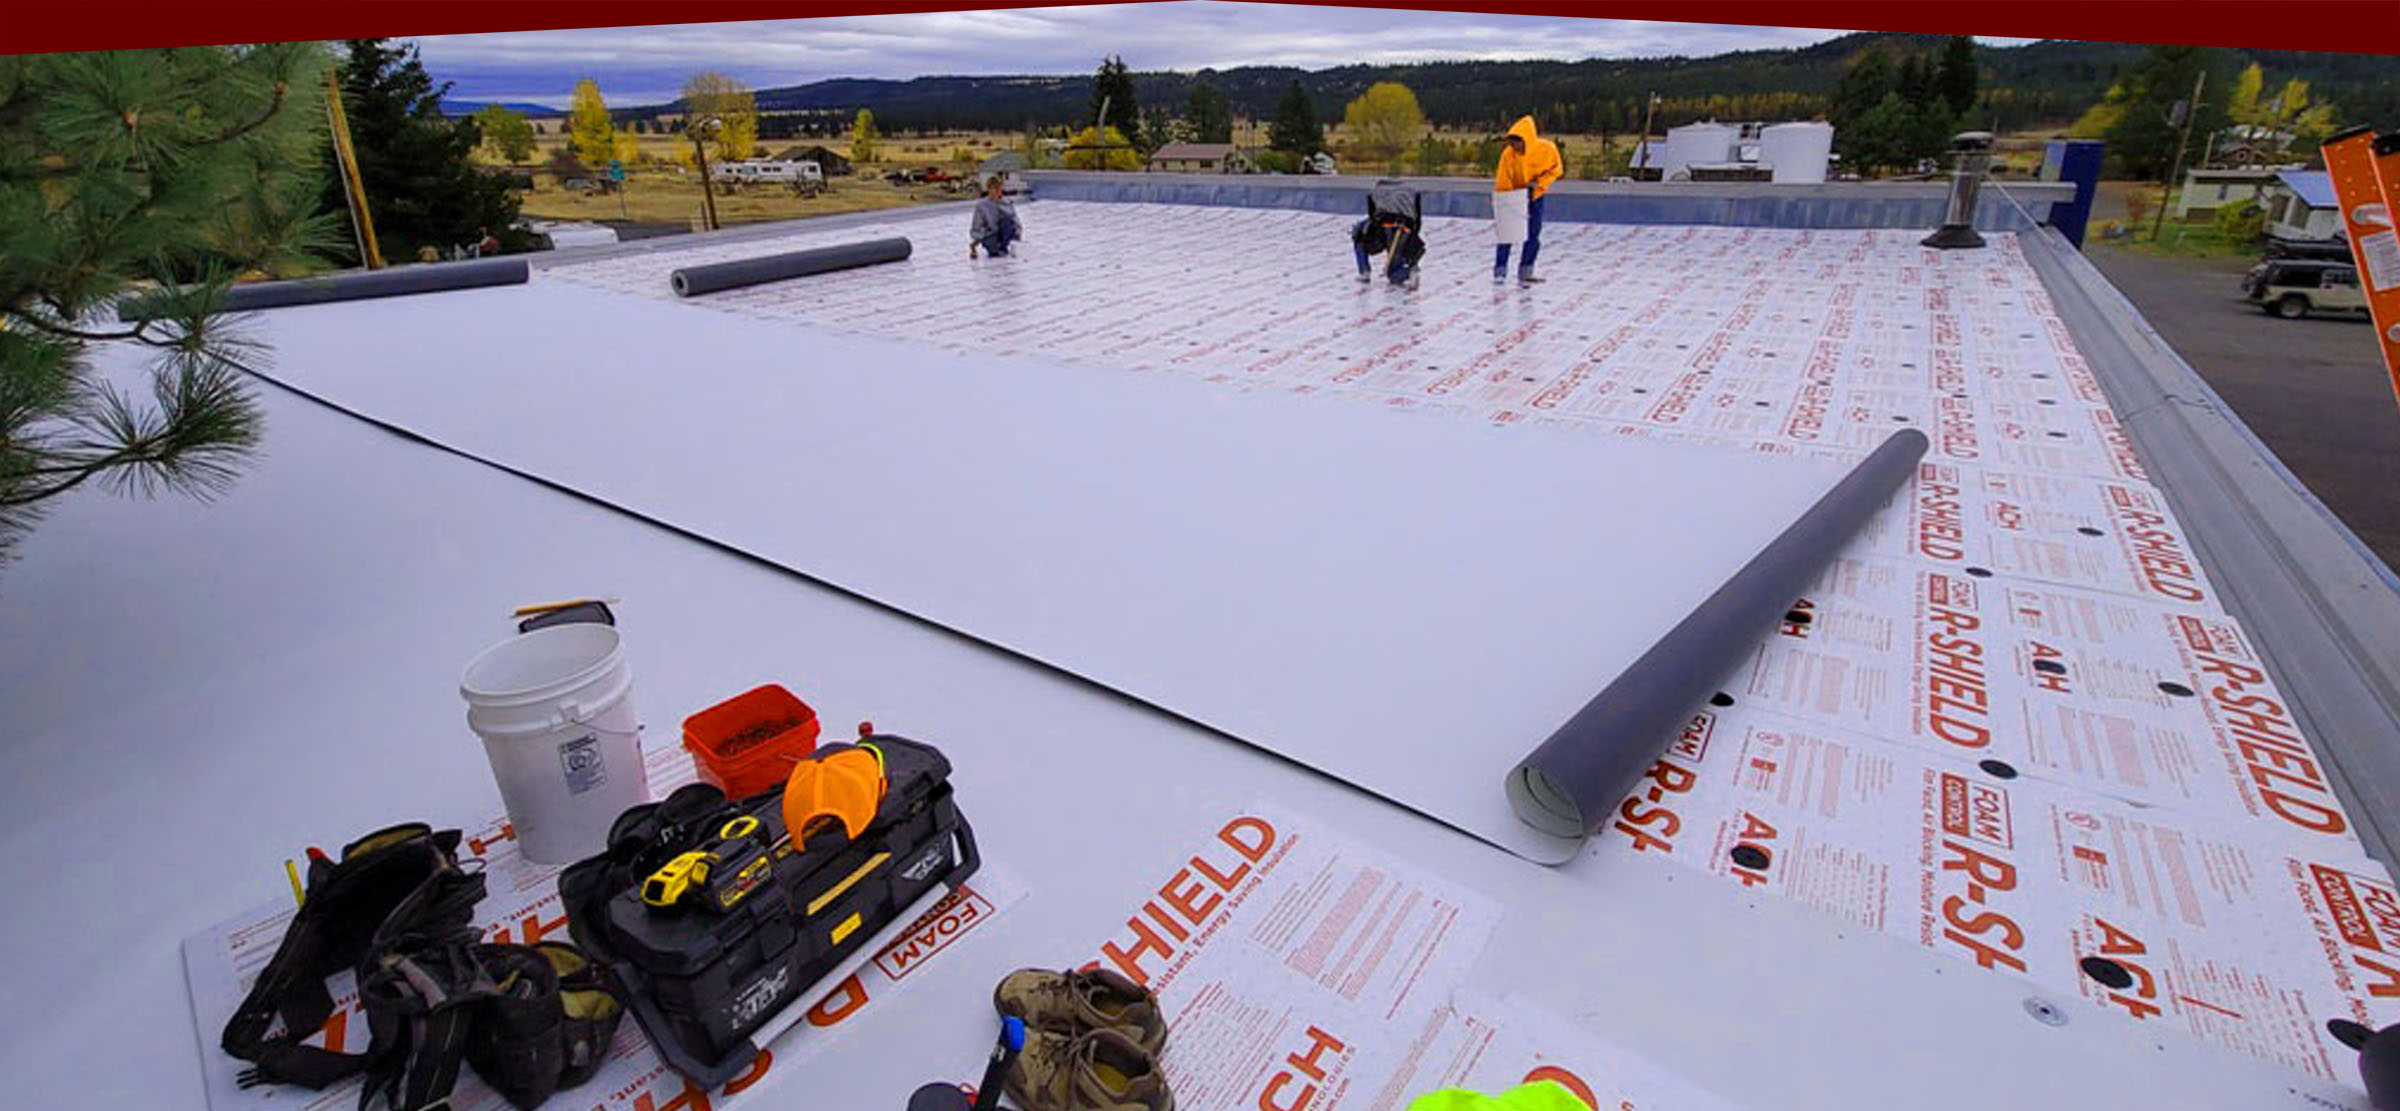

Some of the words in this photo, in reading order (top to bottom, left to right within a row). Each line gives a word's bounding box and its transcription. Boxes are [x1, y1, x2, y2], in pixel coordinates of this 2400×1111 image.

[1929, 607, 1990, 749] R-SHIELD
[2201, 657, 2346, 835] R-SHIELD
[1972, 785, 2001, 846] FOAM
[893, 902, 979, 969] FOAM
[1075, 816, 1277, 985] HIELD
[1192, 908, 1233, 949] Energy
[1227, 875, 1263, 910] Saving
